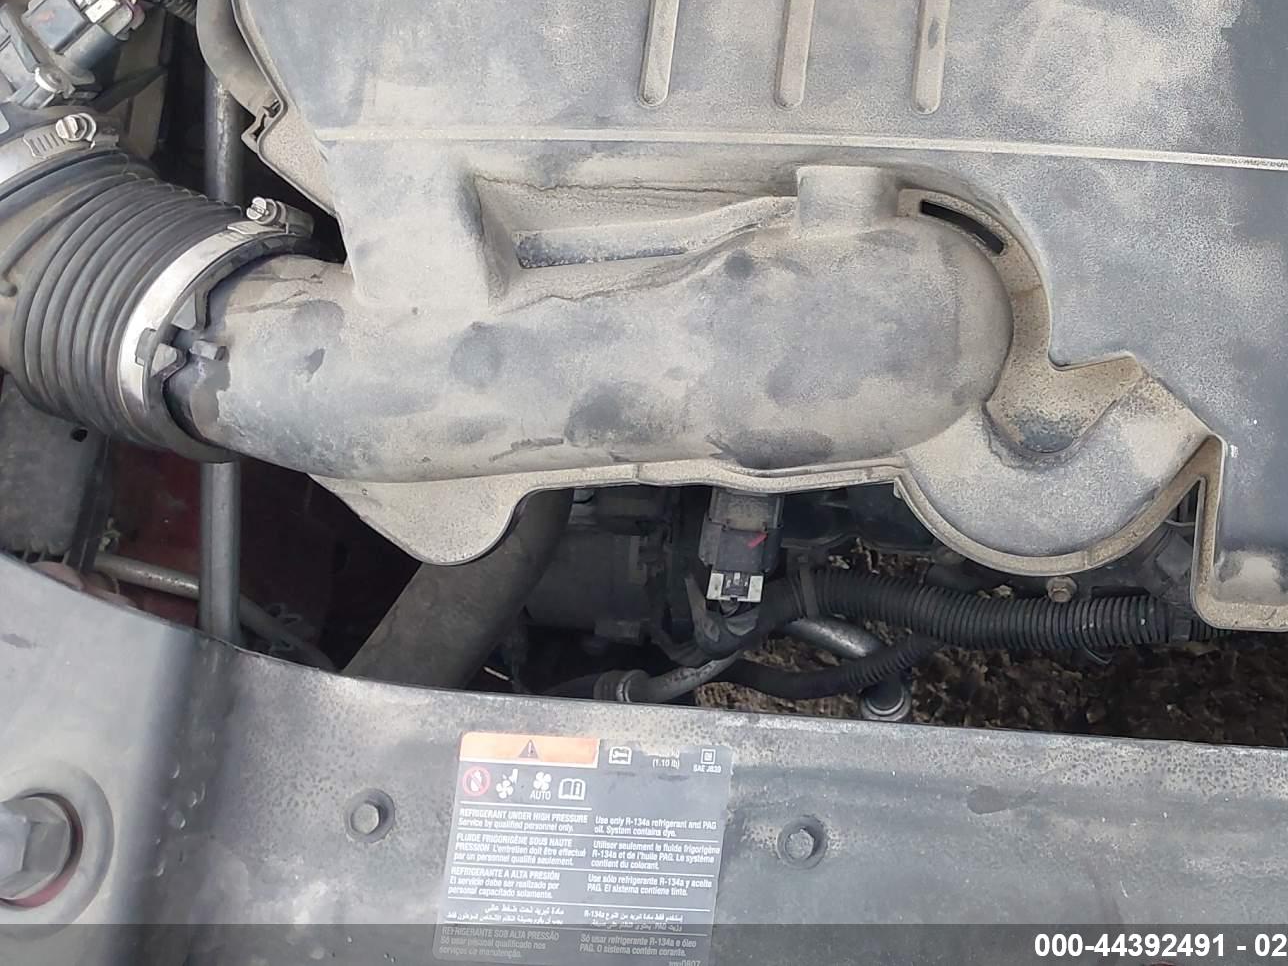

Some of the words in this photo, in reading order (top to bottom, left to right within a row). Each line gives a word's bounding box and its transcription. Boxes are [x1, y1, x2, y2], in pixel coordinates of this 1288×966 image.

[530, 790, 551, 801] AUTO
[460, 808, 508, 820] REFRIGERANT
[508, 811, 532, 820] UNDER
[533, 812, 550, 821] HIGH
[551, 813, 588, 823] PRESSURE
[458, 818, 482, 826] Service
[484, 819, 492, 828] by
[494, 819, 523, 829] qualified
[524, 821, 558, 831] personnel
[558, 823, 573, 833] only.
[595, 816, 608, 825] Use
[610, 817, 624, 826] only
[625, 817, 650, 827] R-134a
[651, 818, 687, 830] refrigerant
[688, 820, 702, 829] and
[702, 821, 717, 830] PAG
[594, 825, 606, 833] oil.
[606, 826, 632, 835] System
[633, 827, 661, 836] contains
[663, 828, 677, 839] dye.
[456, 833, 481, 842] FLUIDE
[529, 836, 548, 846] SOUS
[549, 837, 572, 847] HAUTE
[591, 859, 619, 868] contient
[620, 860, 628, 868] du
[630, 860, 660, 870] colorant.
[449, 875, 457, 884] El
[457, 876, 484, 886] servicio
[485, 878, 502, 887] debe
[503, 880, 515, 888] ser
[515, 879, 547, 889] realizado
[547, 882, 560, 891] por
[588, 874, 601, 883] Use
[602, 874, 617, 884] sólo
[618, 876, 658, 886] refrigerante
[659, 877, 684, 887] R-134a
[685, 880, 691, 889] y
[691, 879, 712, 888] aceite
[447, 886, 478, 895] personal
[478, 887, 516, 897] capacitado
[516, 889, 553, 899] solamente.
[587, 883, 603, 892] PAG.
[604, 884, 612, 892] El
[612, 884, 639, 894] sistema
[640, 886, 670, 896] contiene
[671, 887, 688, 896] tinte.
[580, 934, 591, 942] Só
[591, 936, 607, 944] usar
[607, 936, 648, 946] refrigerante
[649, 937, 675, 947] R-134a
[682, 939, 697, 948] óleo
[580, 944, 596, 952] PAG.
[597, 944, 603, 953] O
[603, 945, 631, 954] sistema
[631, 946, 658, 955] contém
[659, 948, 686, 957] corante.
